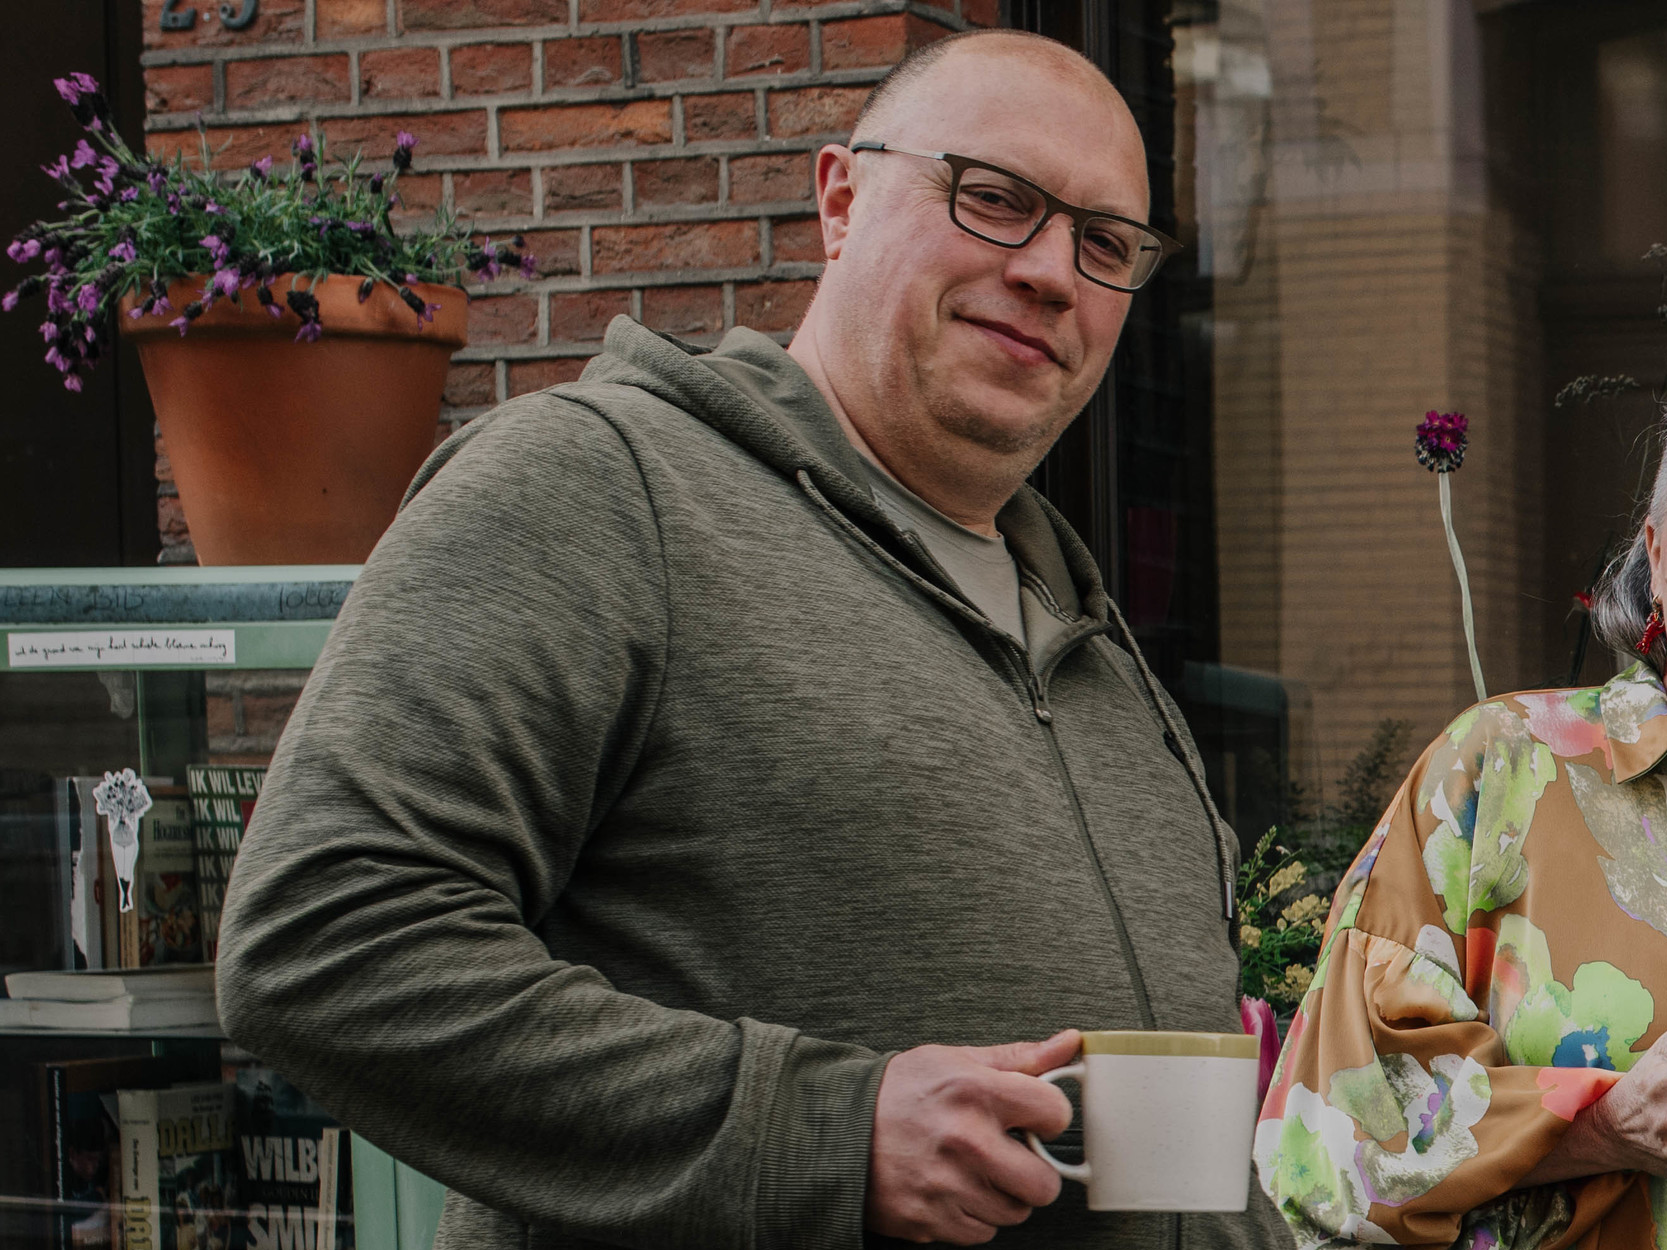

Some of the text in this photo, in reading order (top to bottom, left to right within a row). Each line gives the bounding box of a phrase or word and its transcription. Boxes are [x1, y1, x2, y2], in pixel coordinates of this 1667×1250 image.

[190, 769, 208, 793] IK
[208, 770, 236, 794] WIL
[193, 797, 211, 821] IK
[212, 799, 241, 823] WIL
[195, 826, 214, 849] IK
[198, 855, 218, 878] IK
[200, 883, 220, 906] IK
